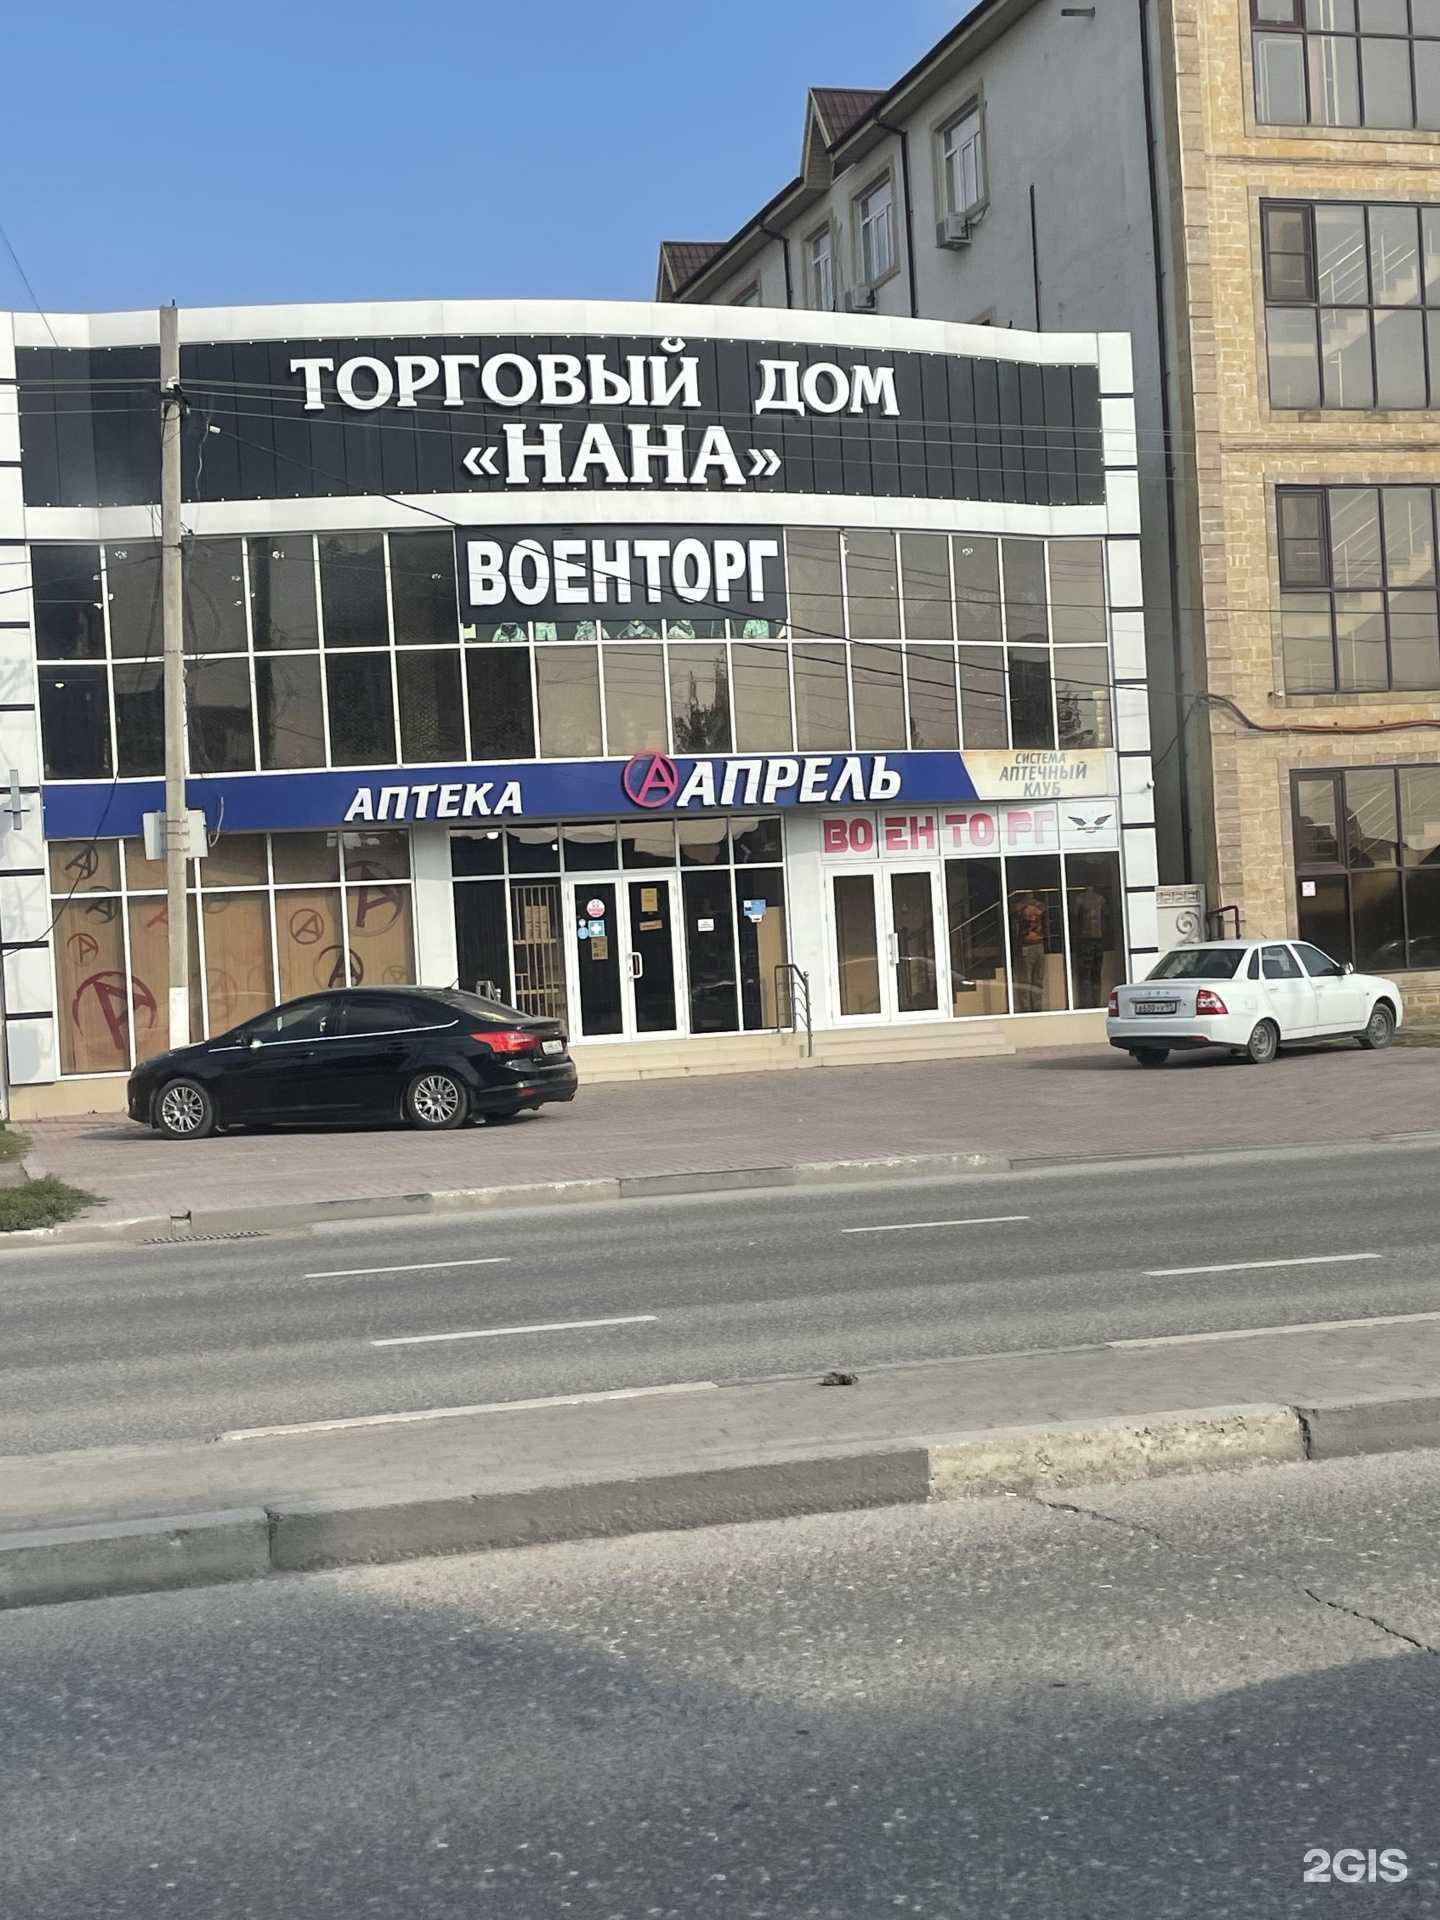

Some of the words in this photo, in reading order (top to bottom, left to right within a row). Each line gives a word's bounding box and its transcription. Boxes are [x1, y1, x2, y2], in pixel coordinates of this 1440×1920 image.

[290, 337, 702, 410] ТОРГОВЫЙ
[753, 359, 900, 417] ДОМ
[462, 424, 782, 486] «НАНА»
[467, 538, 778, 606] ВОЕНТОРГ
[999, 761, 1088, 781] АПТЕЧНЫЙ
[1015, 752, 1066, 764] СИСТЕМА
[344, 781, 523, 821] АПТЕКА
[676, 756, 902, 807] АПРЕЛЬ
[1023, 782, 1061, 797] КЛУБ
